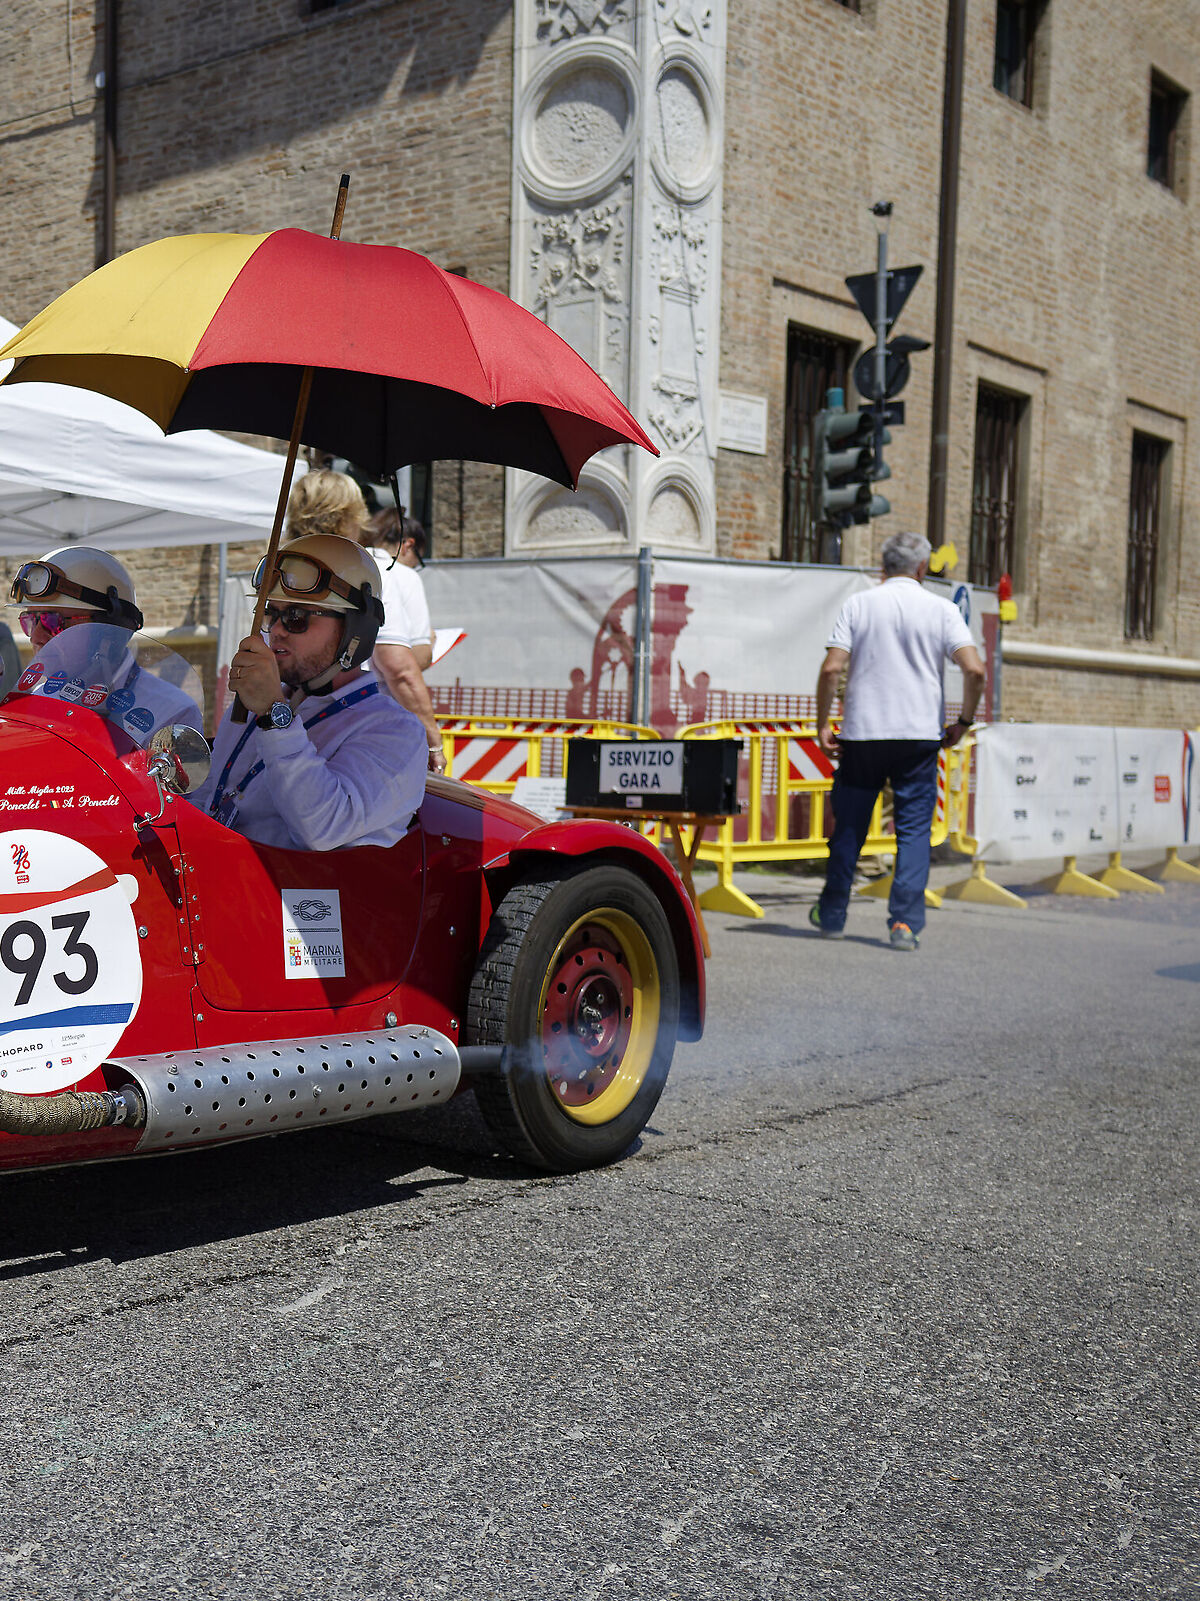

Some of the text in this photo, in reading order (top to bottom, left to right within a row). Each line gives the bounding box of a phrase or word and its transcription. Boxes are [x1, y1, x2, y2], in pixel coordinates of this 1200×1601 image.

[609, 750, 674, 766] SERVIZIO
[620, 772, 660, 788] GARA
[4, 786, 26, 796] Mille
[27, 785, 54, 797] Miglia
[78, 795, 120, 808] Poncelet
[303, 945, 341, 956] MARINA
[303, 957, 342, 966] MILITARE
